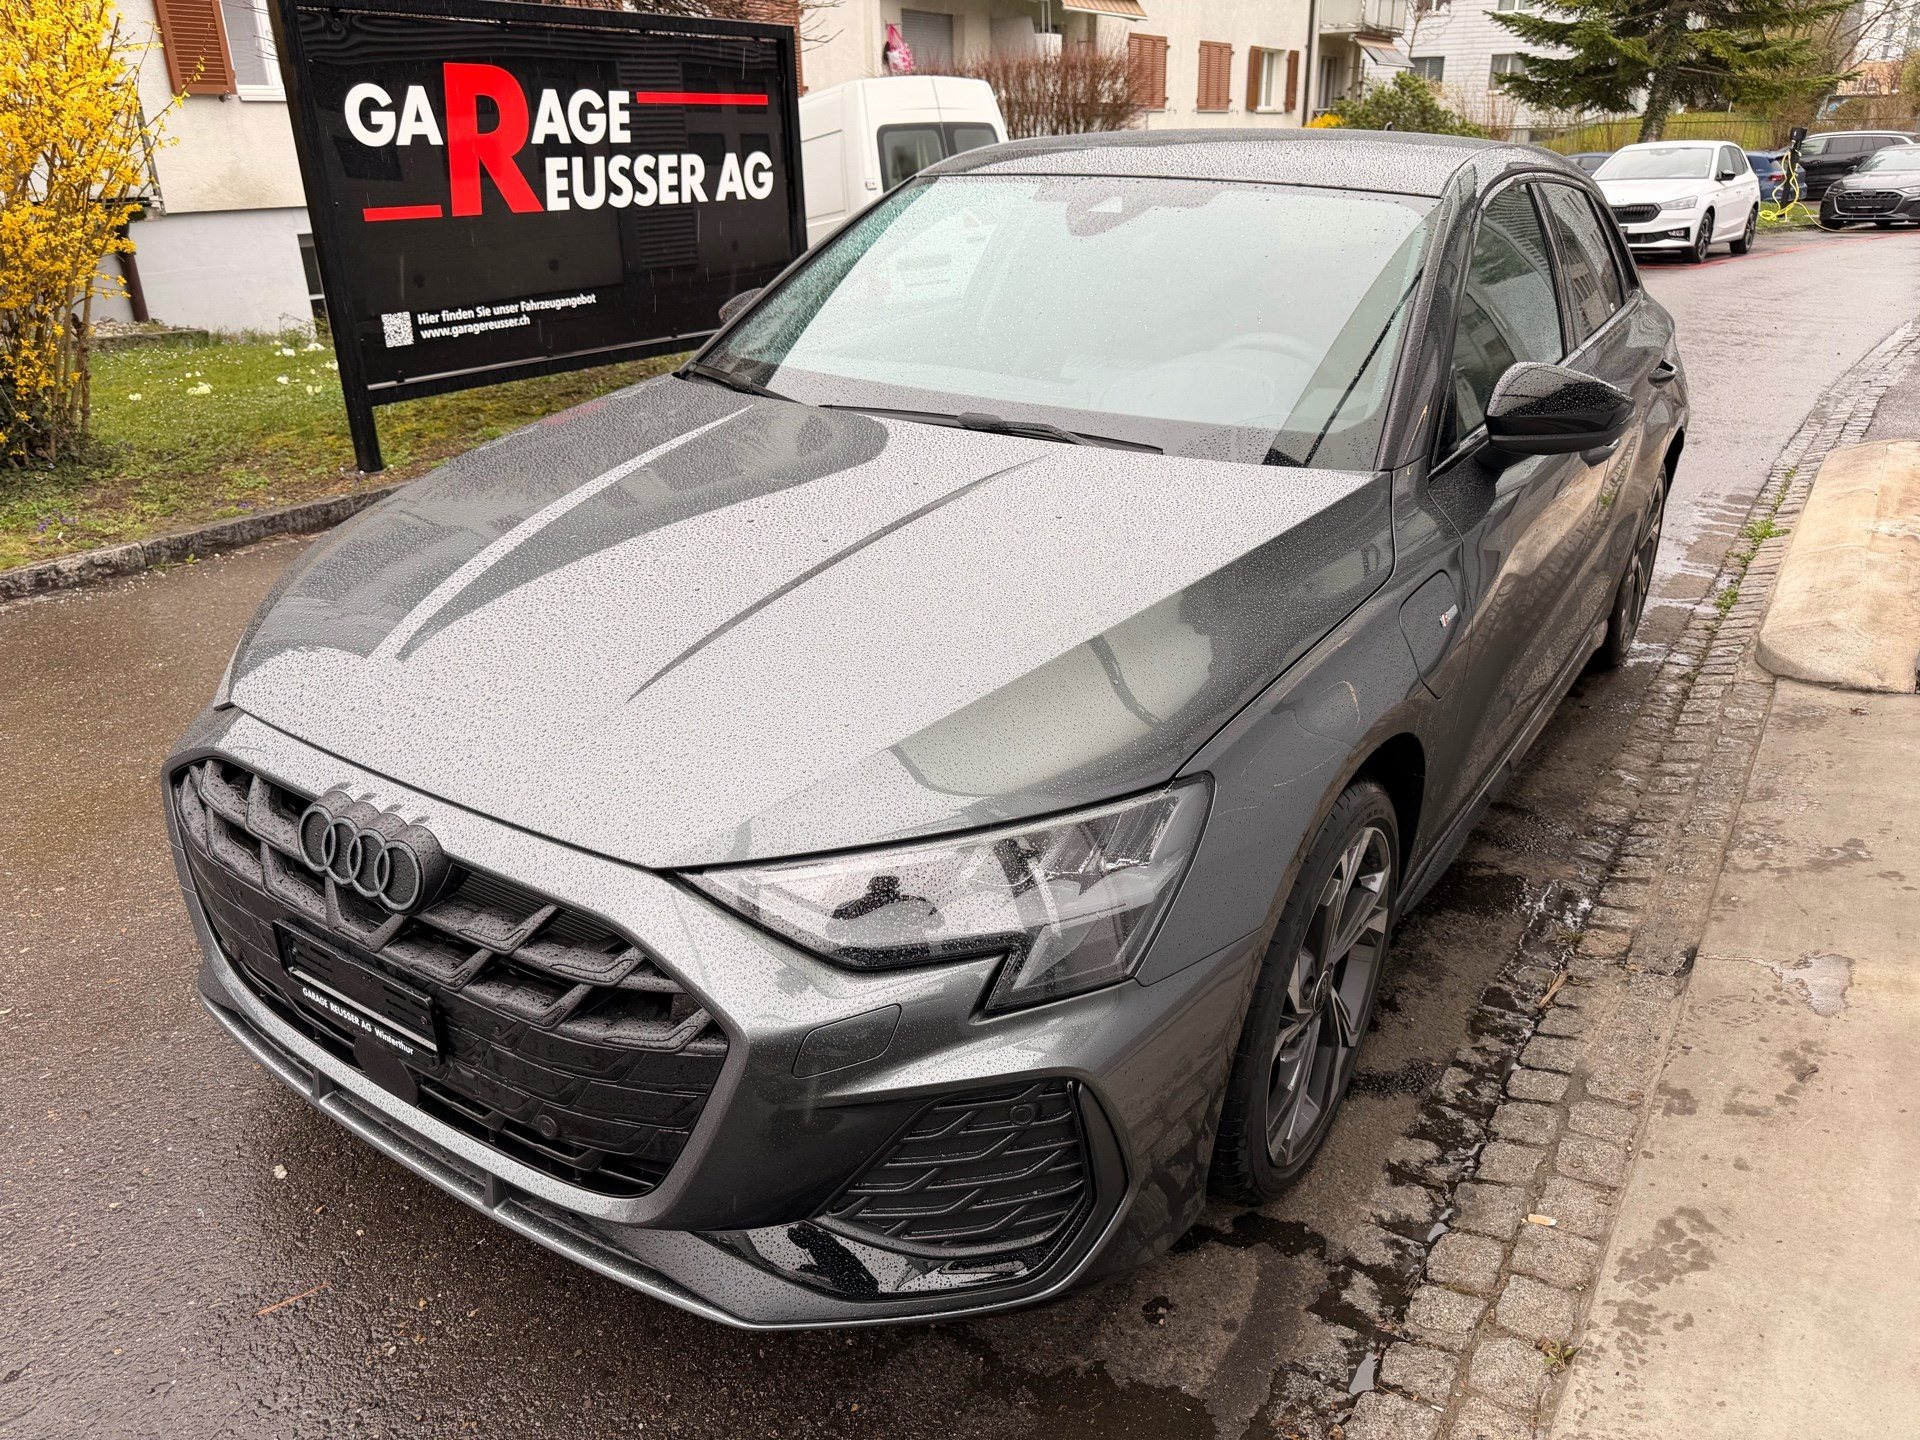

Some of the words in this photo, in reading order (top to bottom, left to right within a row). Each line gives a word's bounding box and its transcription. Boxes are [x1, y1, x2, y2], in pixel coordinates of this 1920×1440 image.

[344, 62, 632, 216] GARAGE
[715, 150, 774, 201] AG
[417, 313, 440, 325] Hier
[441, 307, 475, 322] finden
[475, 305, 492, 318] Sie
[494, 303, 519, 314] unser
[520, 292, 597, 312] Fahrzeugangebot
[420, 314, 531, 340] www.garagereusser.ch
[302, 987, 329, 1008] GARAGE
[329, 1002, 361, 1026] REUSSER
[361, 1020, 373, 1033] AG
[374, 1027, 414, 1055] Winterthur
